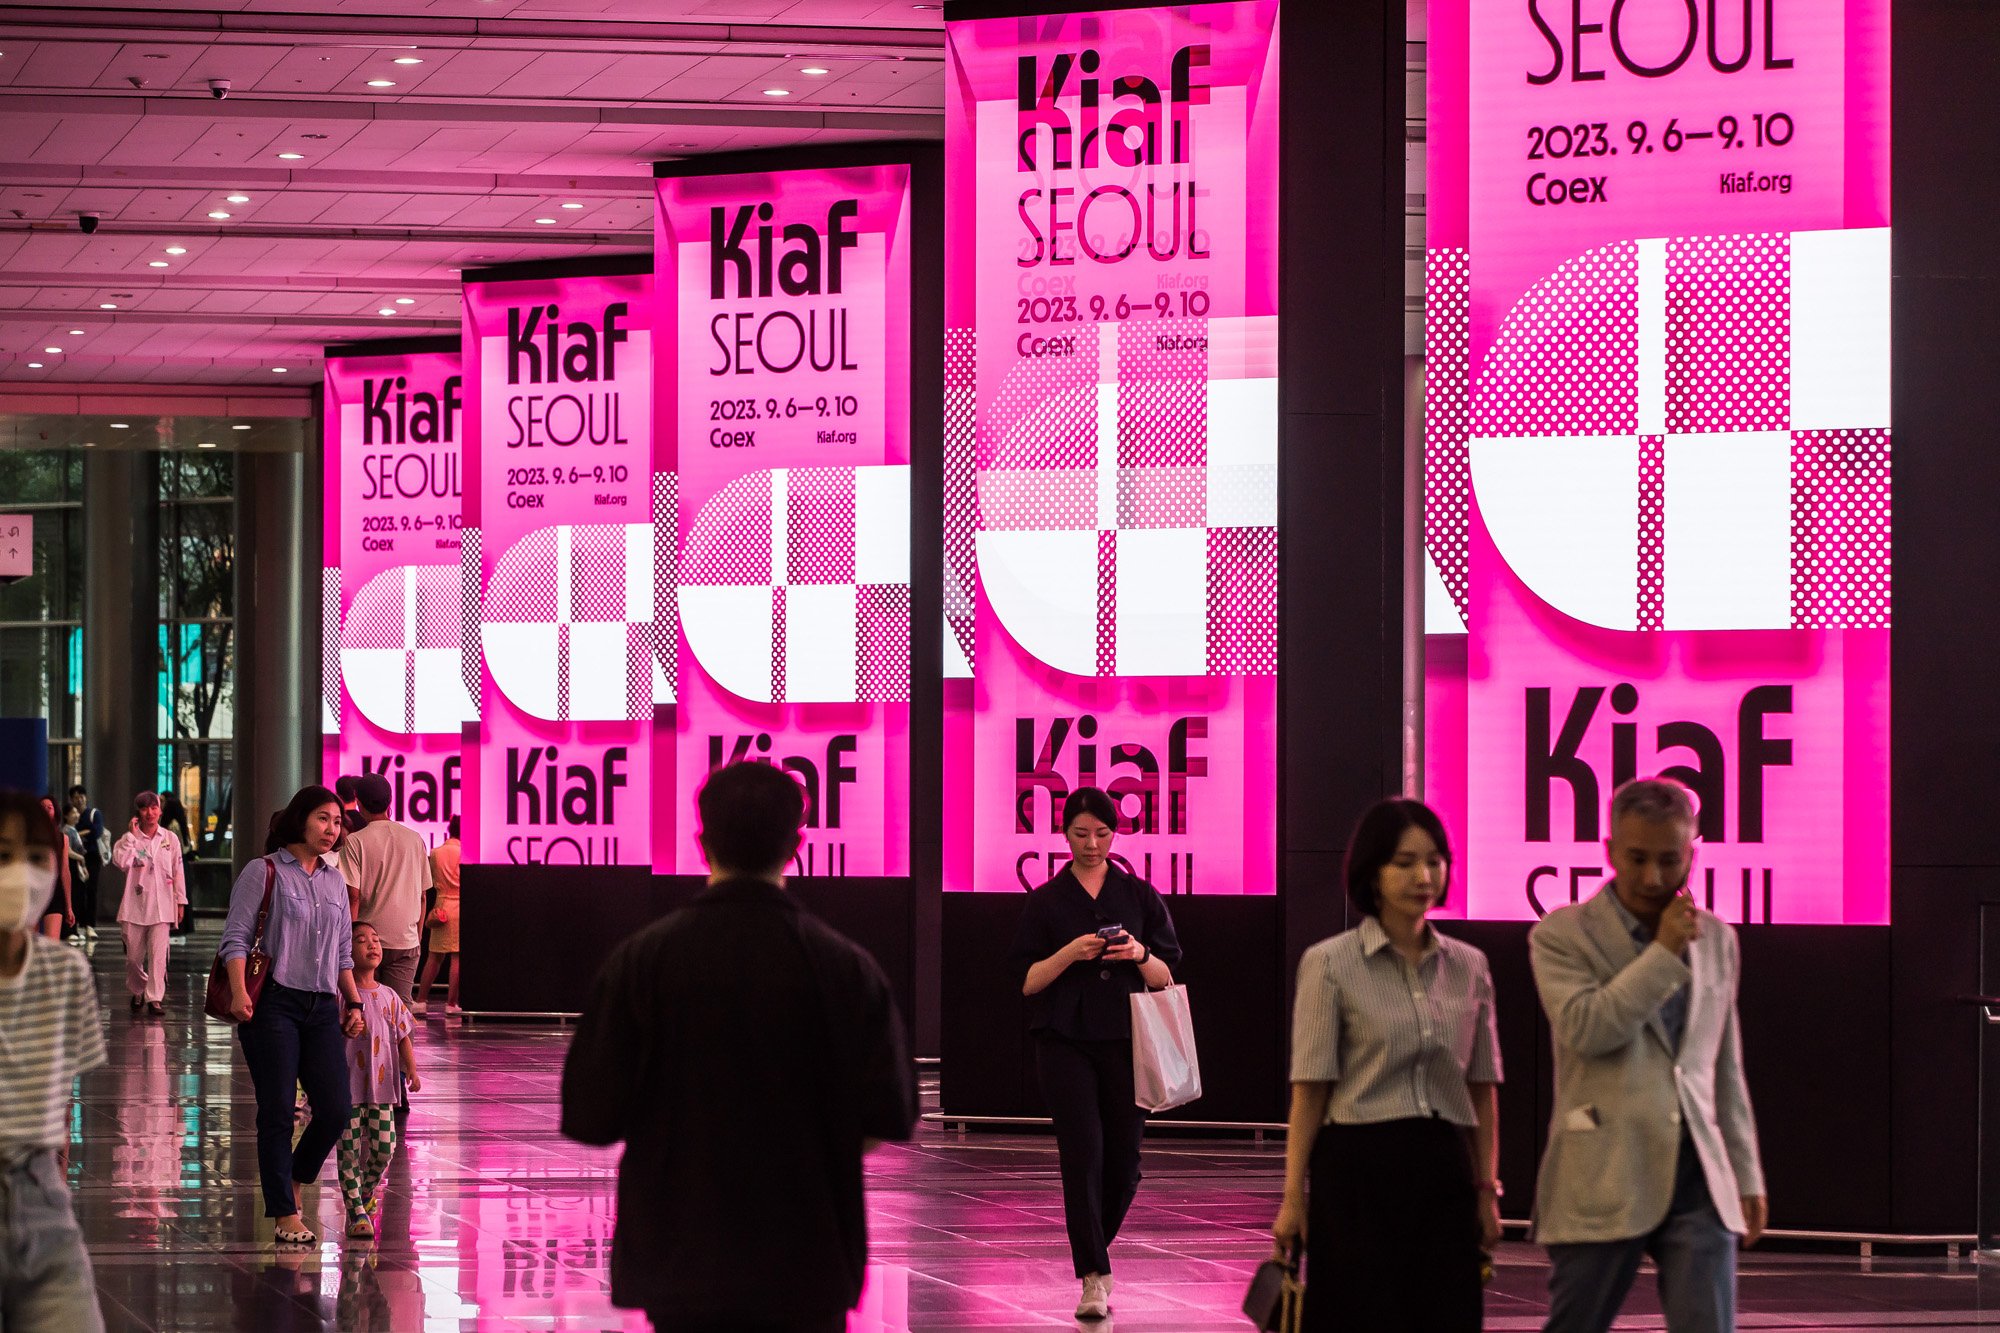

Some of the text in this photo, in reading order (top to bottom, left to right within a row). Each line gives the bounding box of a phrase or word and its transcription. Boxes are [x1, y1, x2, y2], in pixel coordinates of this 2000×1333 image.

[1528, 0, 1793, 85] SEOUL
[1018, 44, 1210, 173] Kiaf
[1528, 113, 1793, 159] 2023. 9. 6—9. 10
[1527, 173, 1607, 205] Coex
[1720, 172, 1792, 194] Kiaf.org
[1017, 181, 1210, 267] SEOUL
[711, 199, 858, 299] Kiaf
[1017, 271, 1076, 297] Coex
[1018, 296, 1084, 323] 2023.
[1090, 295, 1109, 320] 9.
[1180, 291, 1210, 316] 10
[508, 302, 628, 384] Kiaf
[710, 308, 857, 376] SEOUL
[1017, 332, 1076, 358] Coex
[1156, 335, 1208, 352] Kiaf.org
[363, 376, 462, 445] Kiaf
[508, 393, 628, 447] SEOUL
[711, 400, 760, 420] 2023.
[766, 399, 780, 418] 9.
[835, 396, 858, 415] 10
[710, 428, 755, 448] Coex
[817, 431, 856, 444] Kiaf.org
[363, 453, 462, 499] SEOUL
[508, 469, 548, 484] 2023.
[552, 468, 564, 483] 9.
[609, 466, 628, 481] 10
[507, 492, 544, 508] Coex
[594, 493, 627, 506] Kiaf.org
[363, 518, 398, 530] 2023.
[401, 517, 411, 529] 9.
[448, 516, 462, 528] 10
[363, 537, 394, 551] Coex
[709, 733, 857, 829] af
[1016, 714, 1208, 835] Kiaf
[1526, 683, 1793, 842] Kiaf
[507, 746, 627, 825] Kiaf
